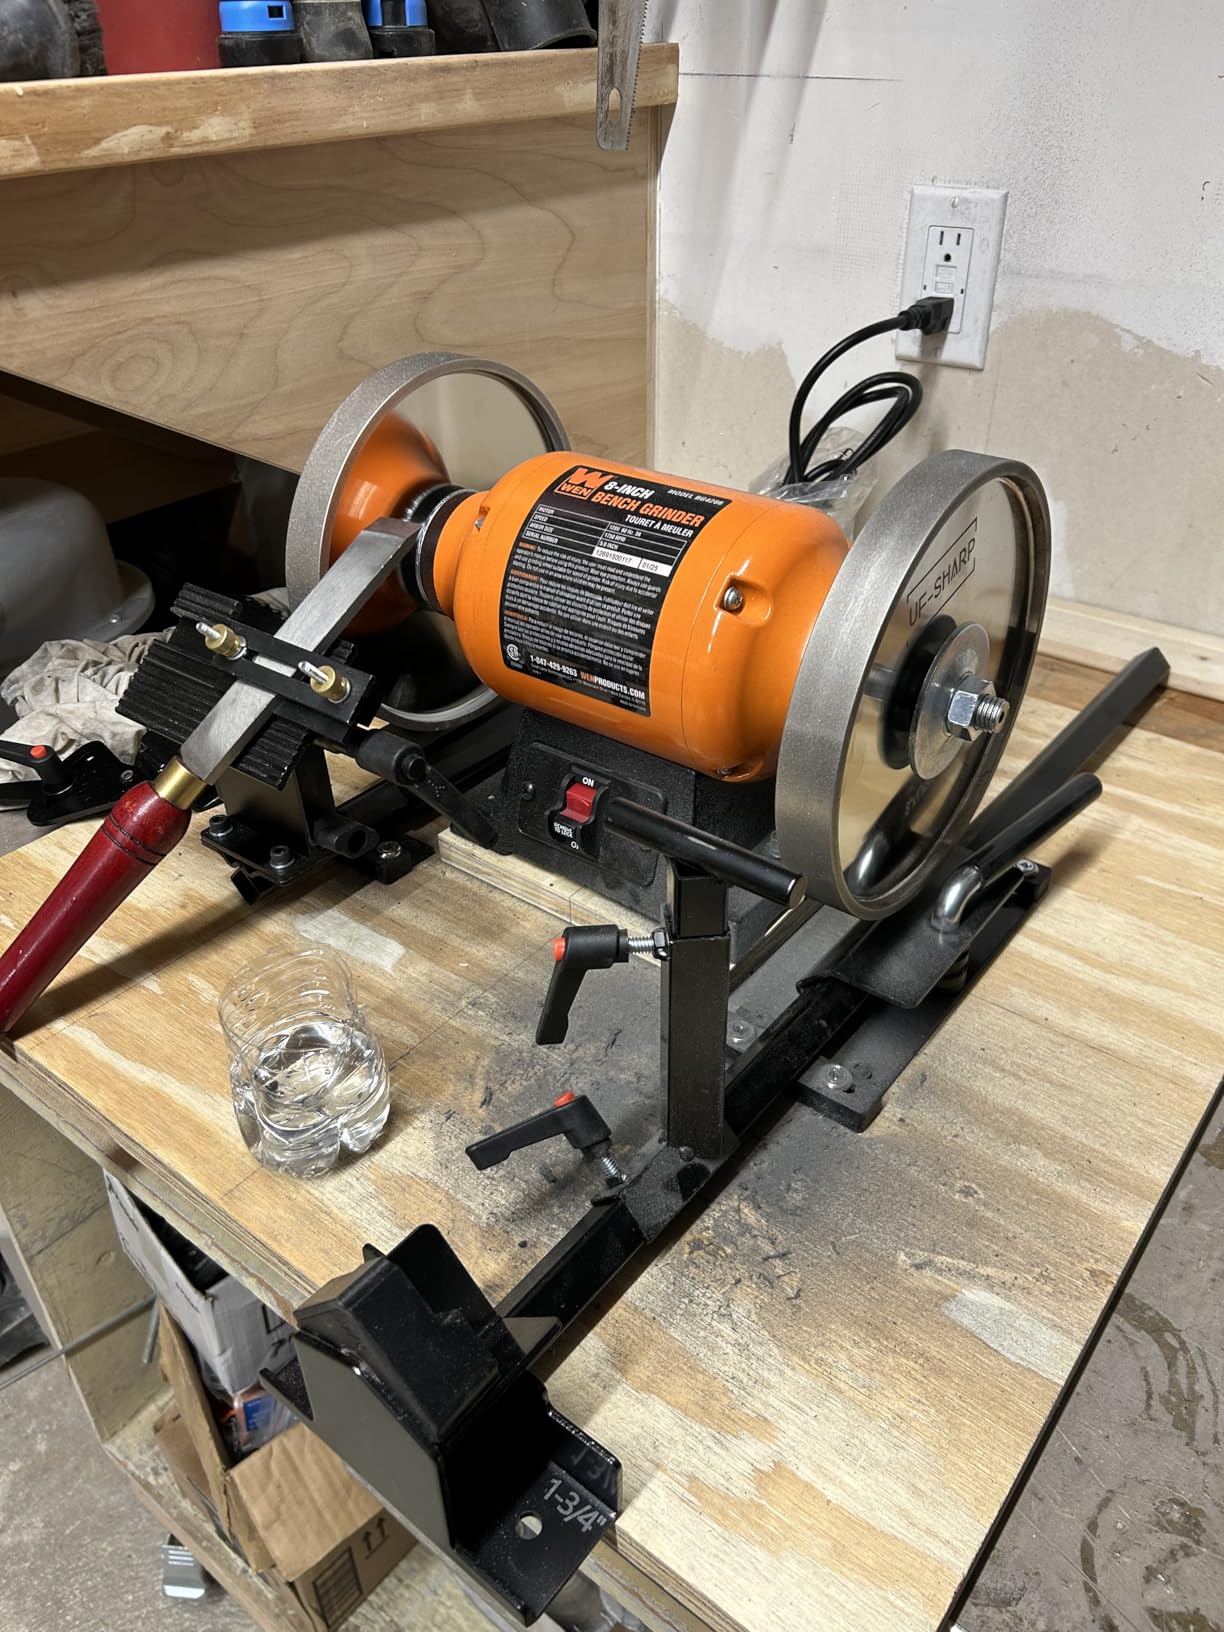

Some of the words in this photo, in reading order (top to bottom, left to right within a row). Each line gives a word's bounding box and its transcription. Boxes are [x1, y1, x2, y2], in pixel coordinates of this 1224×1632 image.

[561, 482, 592, 497] WEN
[604, 481, 655, 499] 8-INCH
[667, 489, 694, 499] MODEL
[591, 491, 641, 512] BENCH
[640, 502, 704, 528] GRINDER
[626, 514, 656, 528] TOURET
[654, 520, 662, 530] À
[661, 523, 694, 538] MEULER
[909, 537, 976, 626] UF-SHARP
[530, 655, 578, 677] 1-847-429-9263
[580, 671, 645, 699] WENPRODUCTS.COM
[582, 777, 594, 787] ON
[543, 1478, 608, 1533] 1-3/4"
